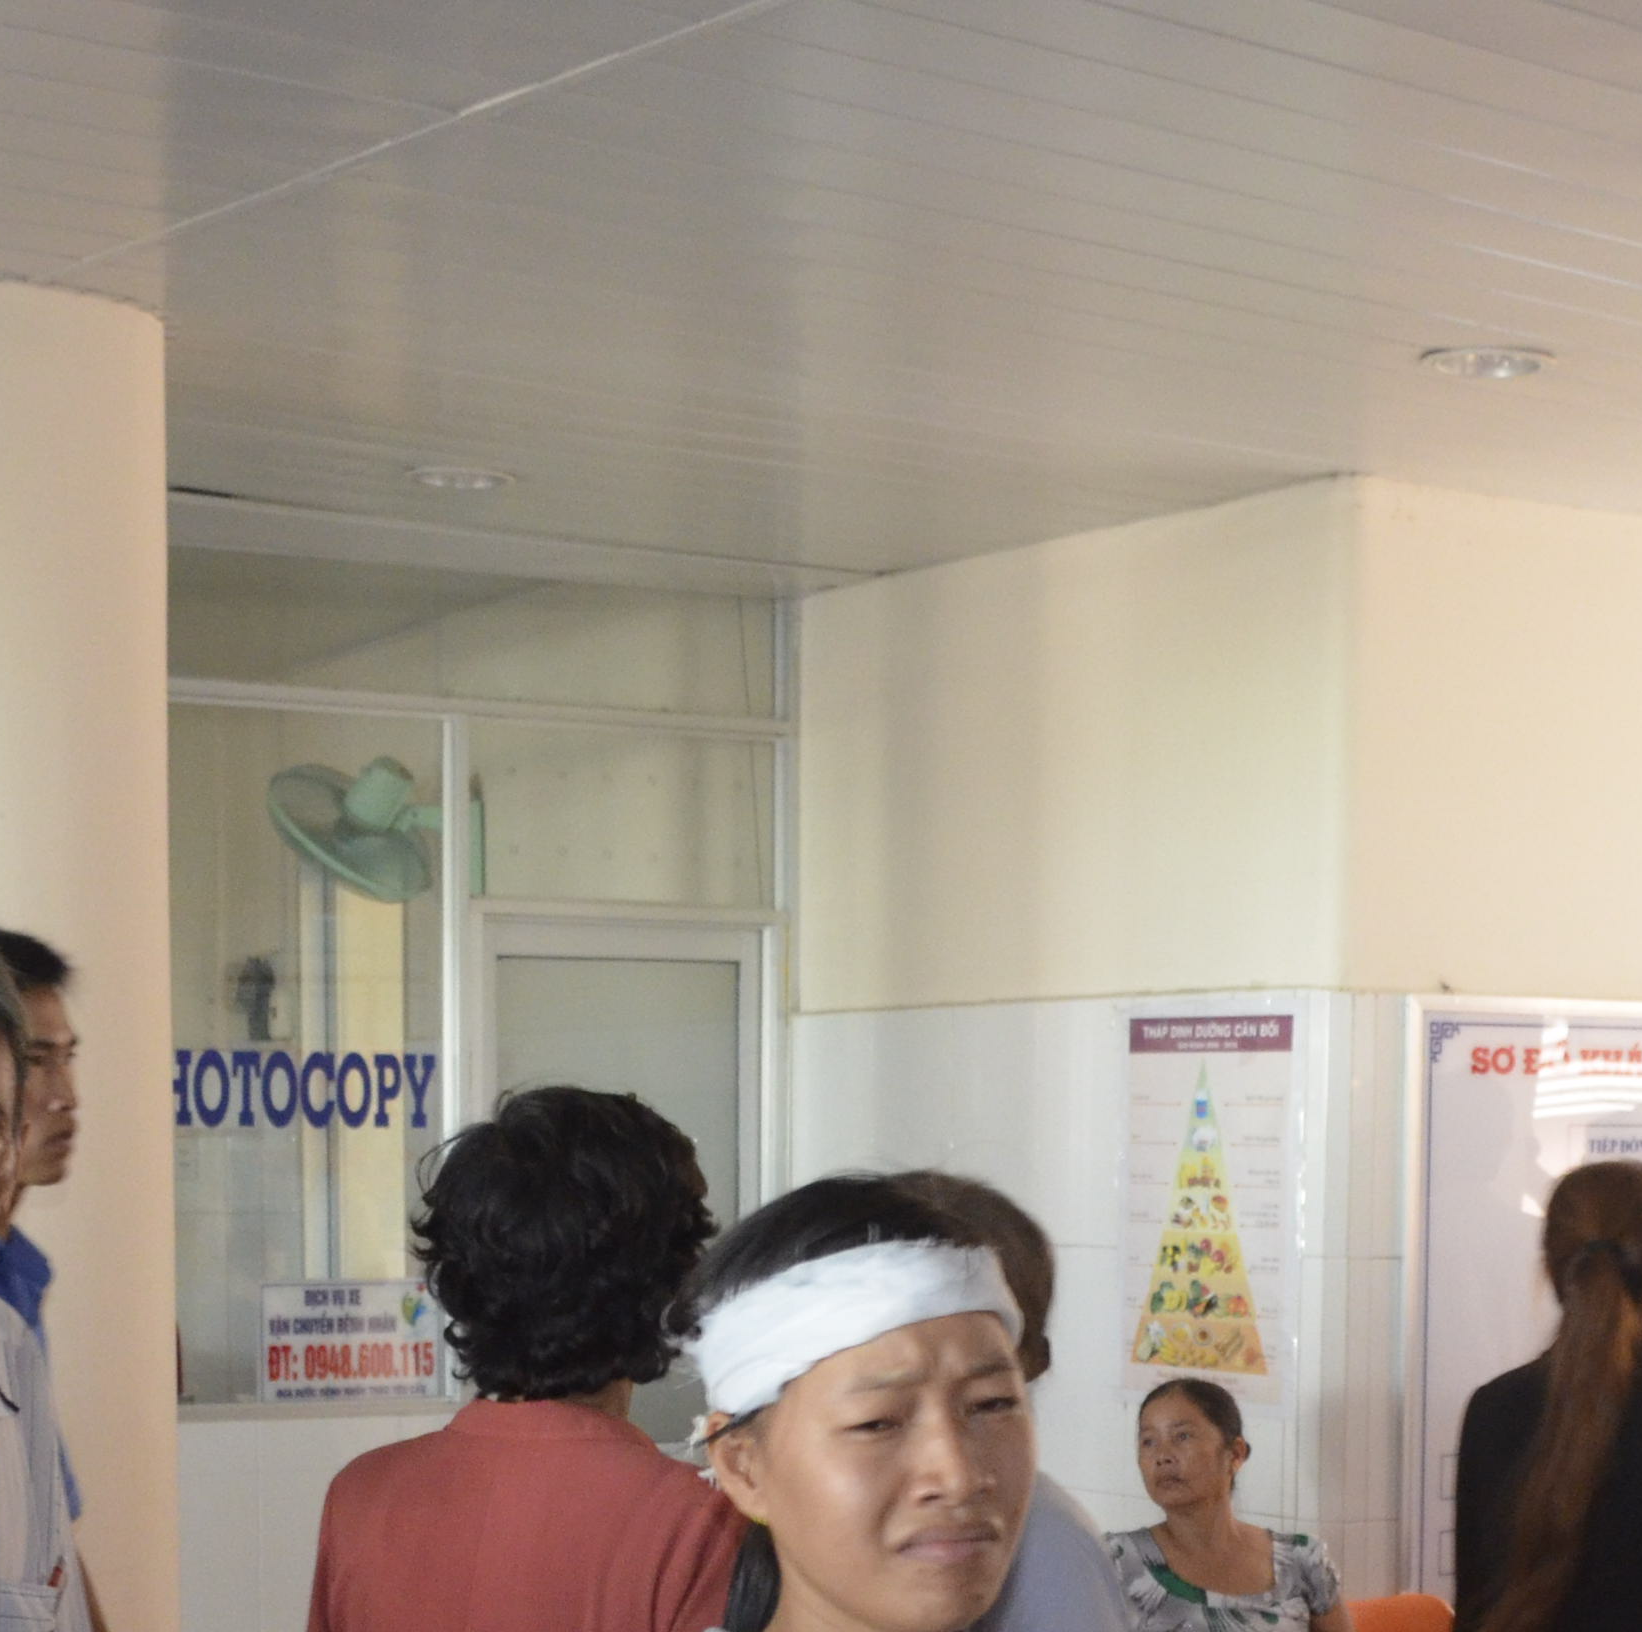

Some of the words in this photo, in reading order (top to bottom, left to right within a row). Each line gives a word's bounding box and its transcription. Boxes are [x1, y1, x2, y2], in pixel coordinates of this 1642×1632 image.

[1471, 1044, 1516, 1076] SƠ
[173, 1049, 436, 1129] HOTOCOPY
[305, 1342, 435, 1380] 0948.600.115
